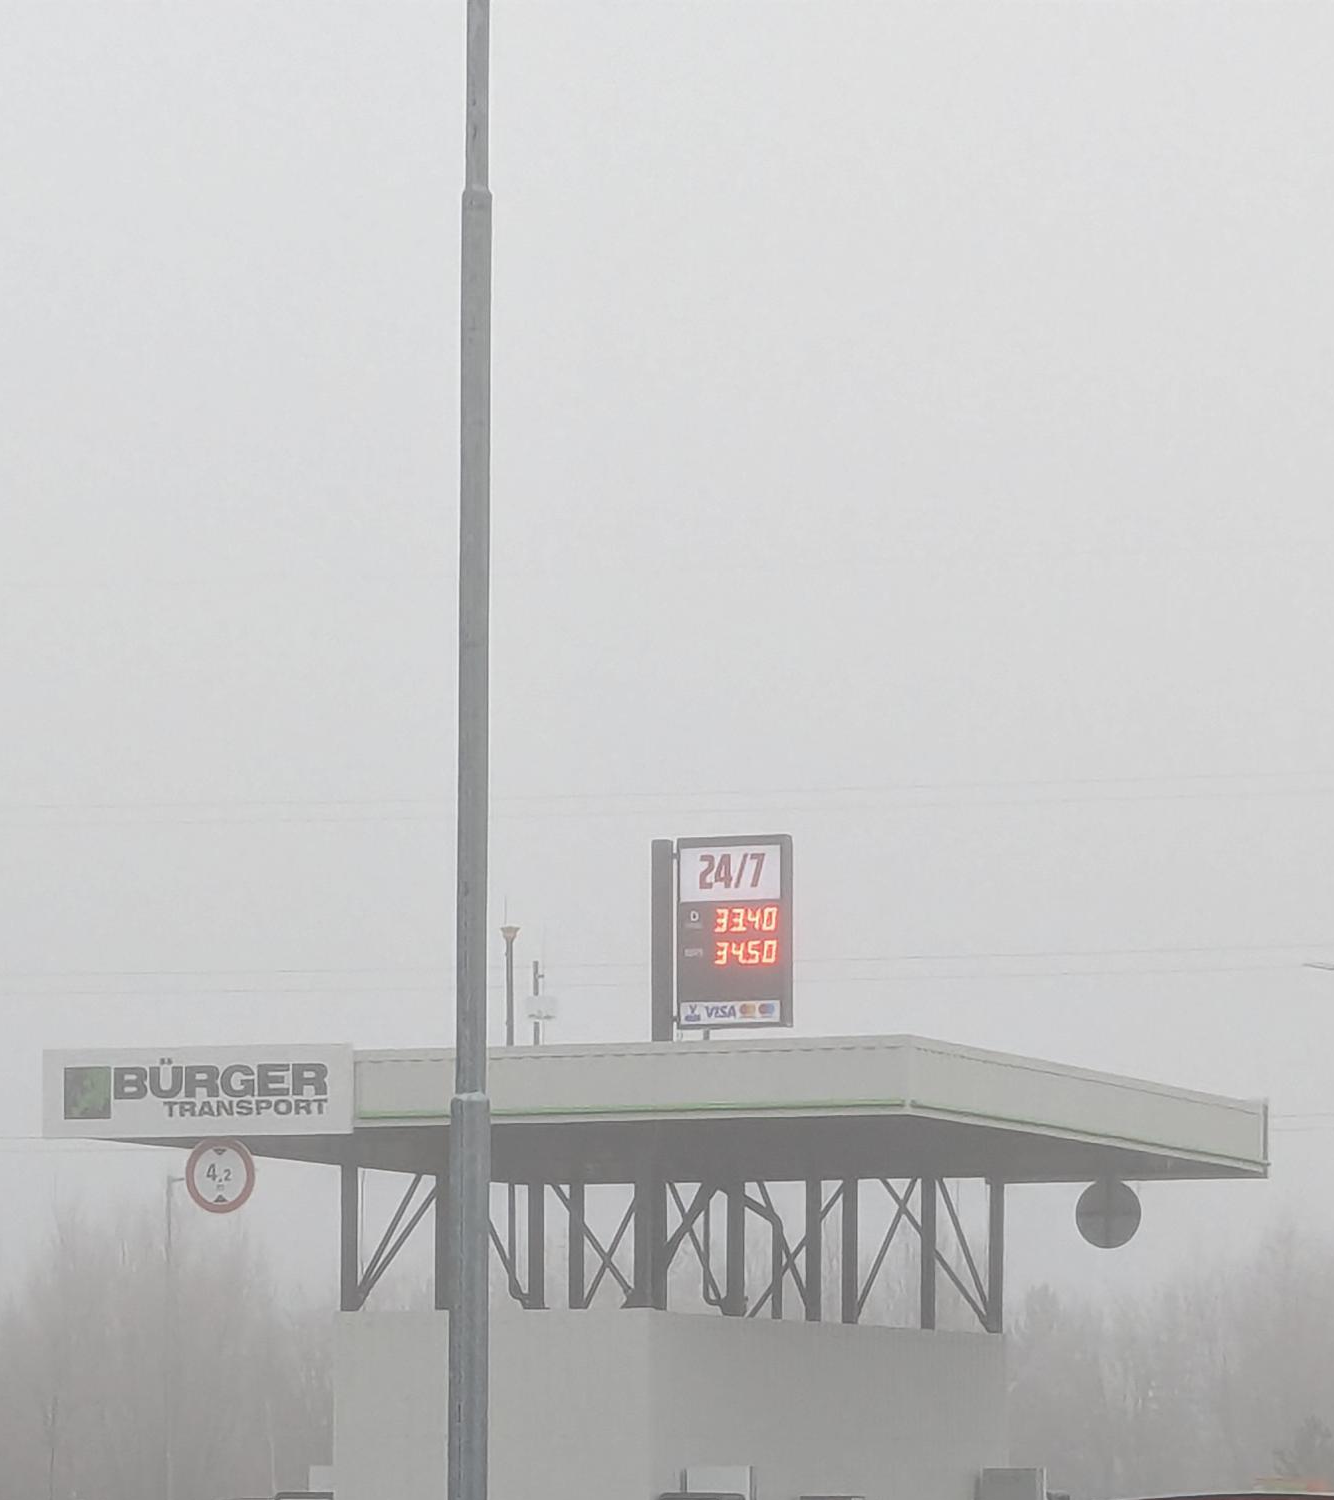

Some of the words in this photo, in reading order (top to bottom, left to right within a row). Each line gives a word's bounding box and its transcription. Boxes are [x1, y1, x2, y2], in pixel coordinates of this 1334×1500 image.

[698, 852, 766, 890] 24/7
[705, 1004, 737, 1019] VISA
[113, 1058, 329, 1101] BÜRGER
[163, 1098, 329, 1118] TRANSPORT
